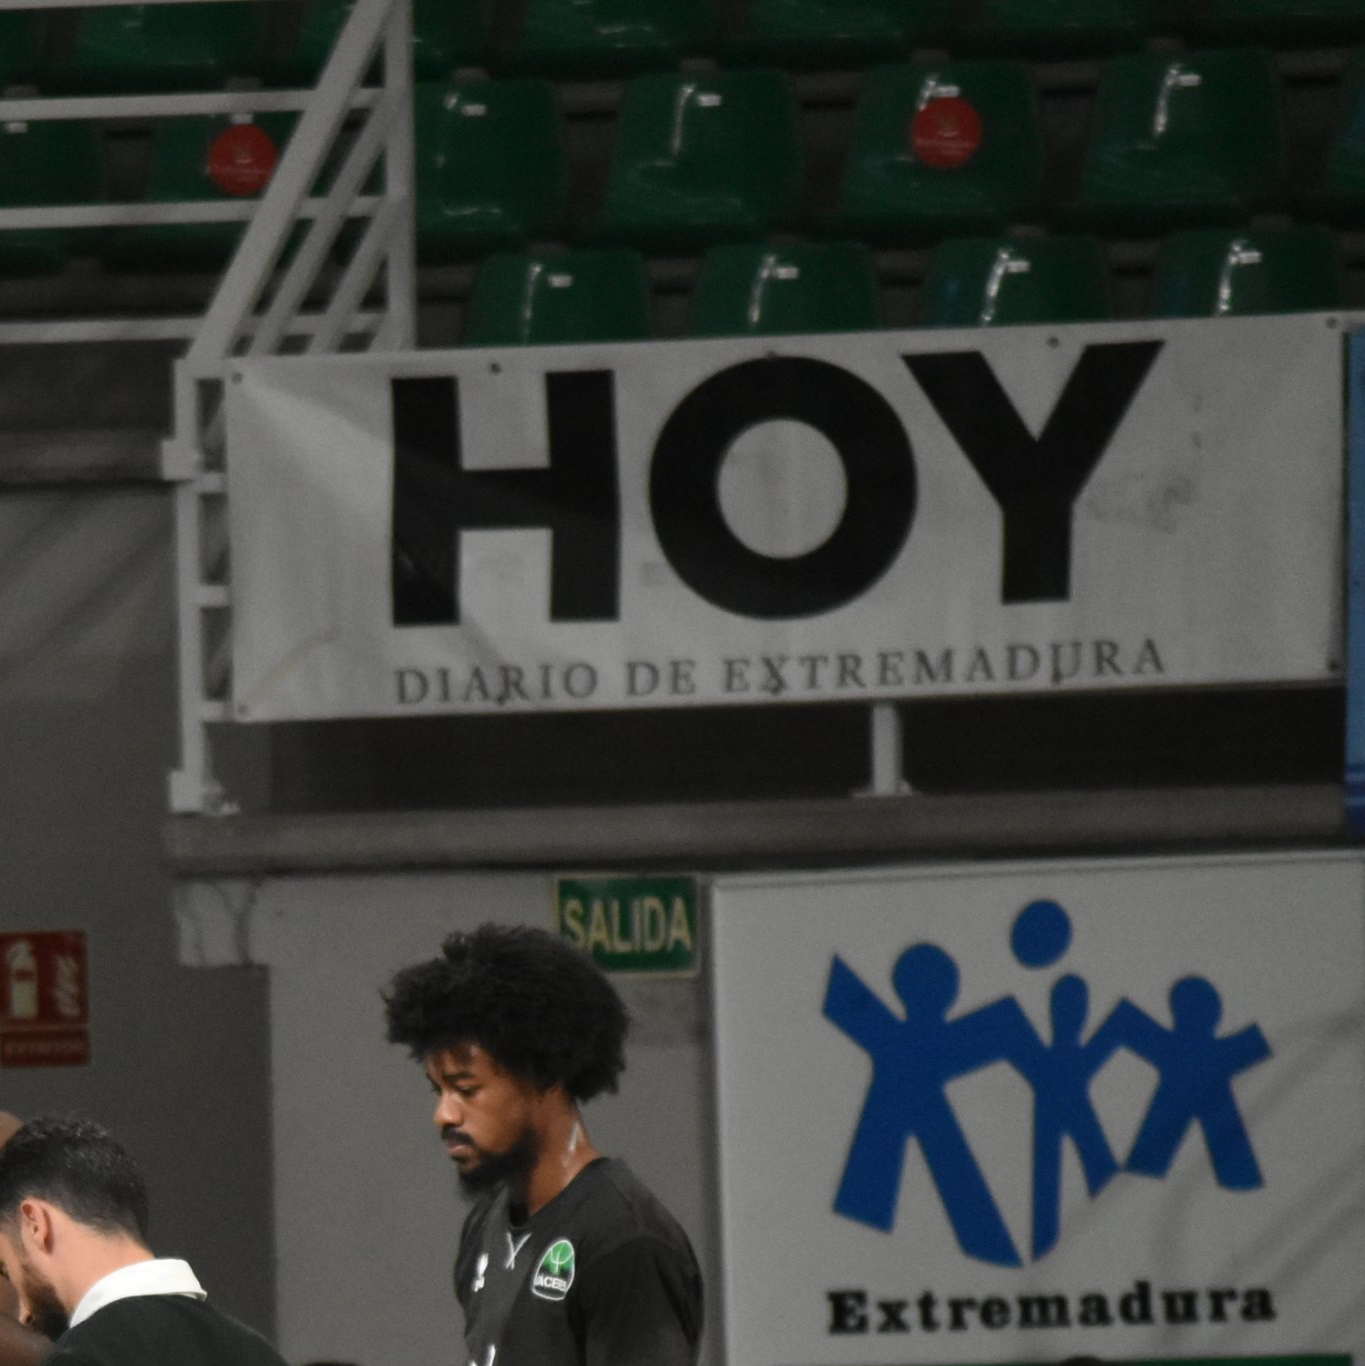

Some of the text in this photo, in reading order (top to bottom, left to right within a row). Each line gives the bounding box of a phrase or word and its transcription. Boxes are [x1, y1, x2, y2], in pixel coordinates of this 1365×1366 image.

[389, 338, 1167, 628] HOY
[394, 638, 1167, 706] DIARIO DE EXTREMADURA
[560, 896, 695, 955] SALIDA
[827, 1281, 1278, 1336] Extremadura
